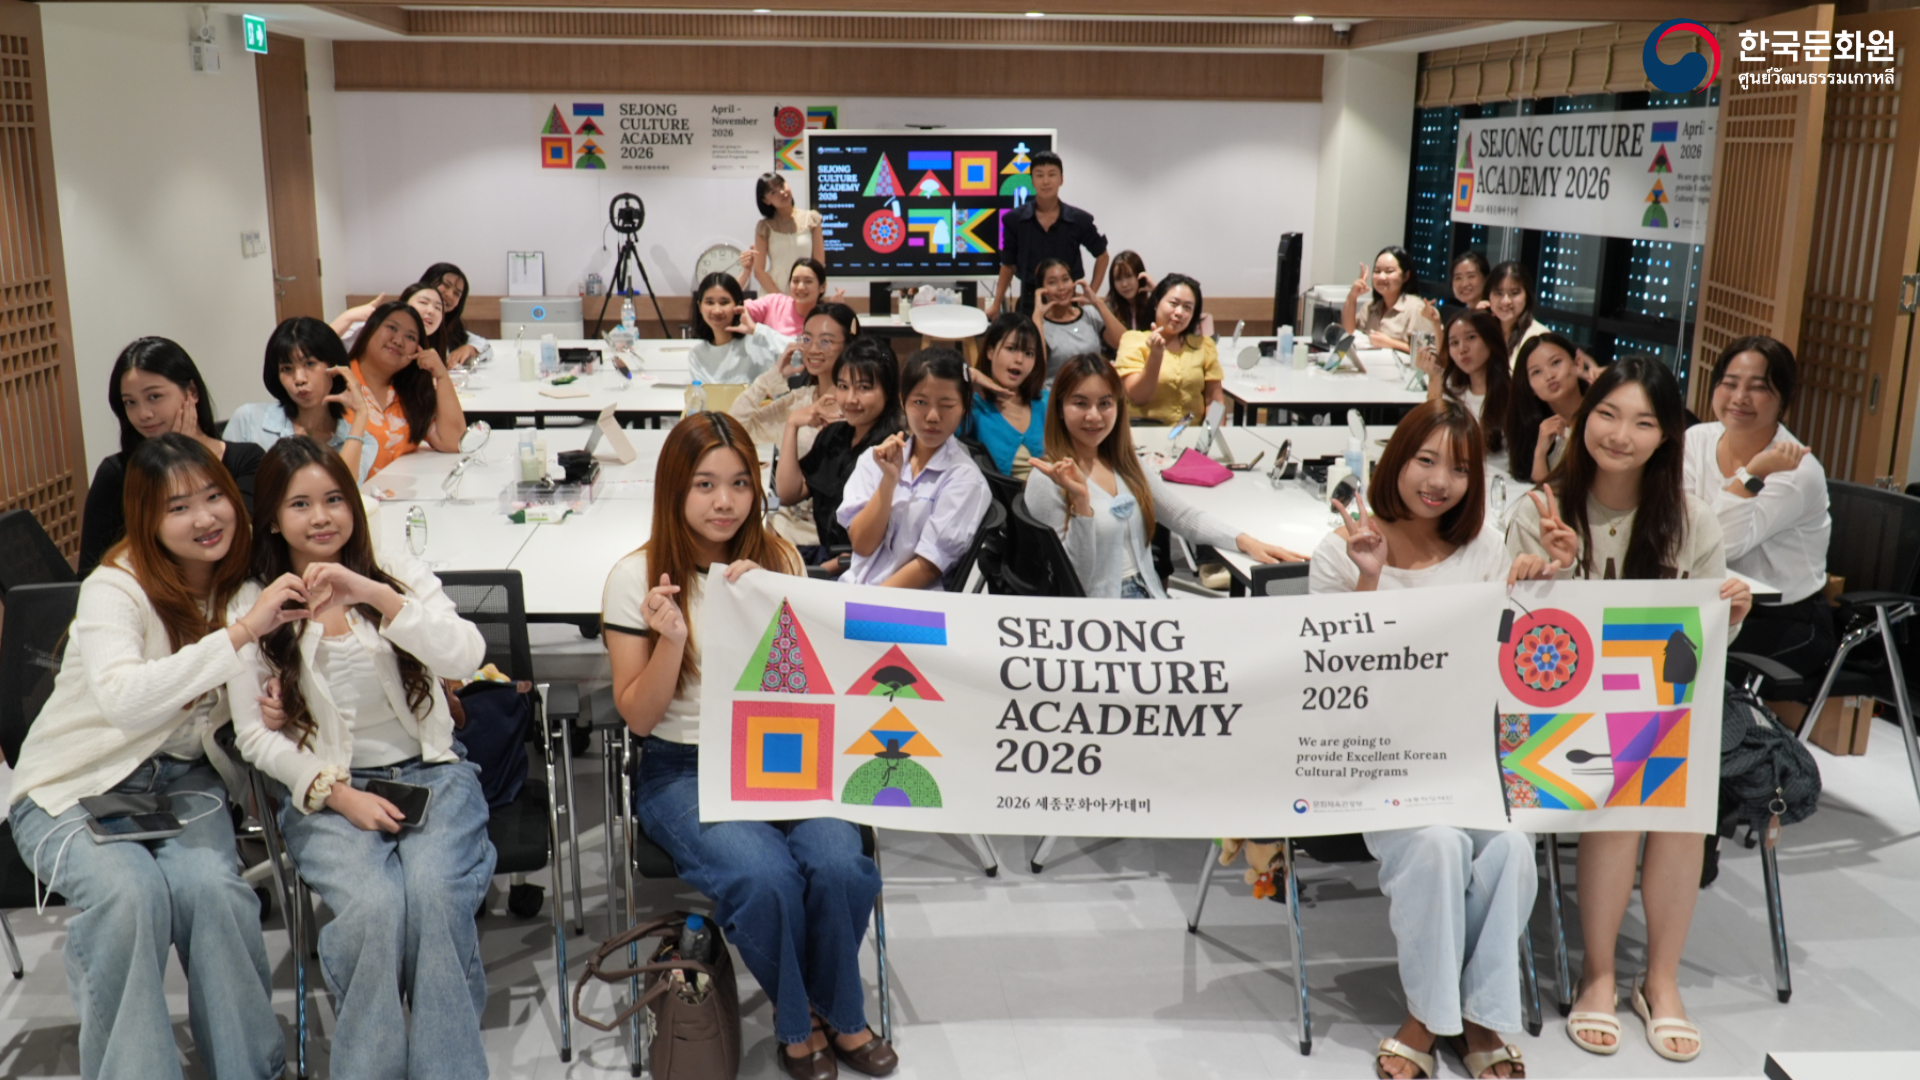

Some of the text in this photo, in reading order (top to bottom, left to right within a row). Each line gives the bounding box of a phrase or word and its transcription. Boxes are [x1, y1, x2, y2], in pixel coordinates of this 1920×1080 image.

[619, 103, 678, 116] SEJONG
[711, 104, 735, 115] April
[619, 117, 690, 131] CULTURE
[711, 116, 759, 126] November
[711, 128, 734, 137] 2026
[1682, 120, 1705, 140] April
[620, 132, 694, 145] ACADEMY
[1478, 123, 1645, 158] SEJONG CULTURE
[620, 146, 654, 159] 2026
[1680, 144, 1702, 159] 2026
[818, 165, 851, 173] SEJONG
[818, 174, 858, 182] CULTURE
[1476, 165, 1610, 200] ACADEMY 2026
[818, 183, 860, 191] ACADEMY
[818, 192, 838, 200] 2026
[998, 616, 1185, 652] SEJONG
[1299, 612, 1375, 643] April
[1303, 646, 1449, 673] November
[1000, 656, 1229, 695] CULTURE
[1302, 685, 1369, 710] 2026
[995, 699, 1243, 737] ACADEMY
[1298, 735, 1391, 749] We are going to
[995, 738, 1102, 776] 2026
[1296, 749, 1447, 764] provide Excellent Korean
[1295, 767, 1409, 780] Cultural Programs
[996, 796, 1151, 813] 2026 세종문화아카데미
